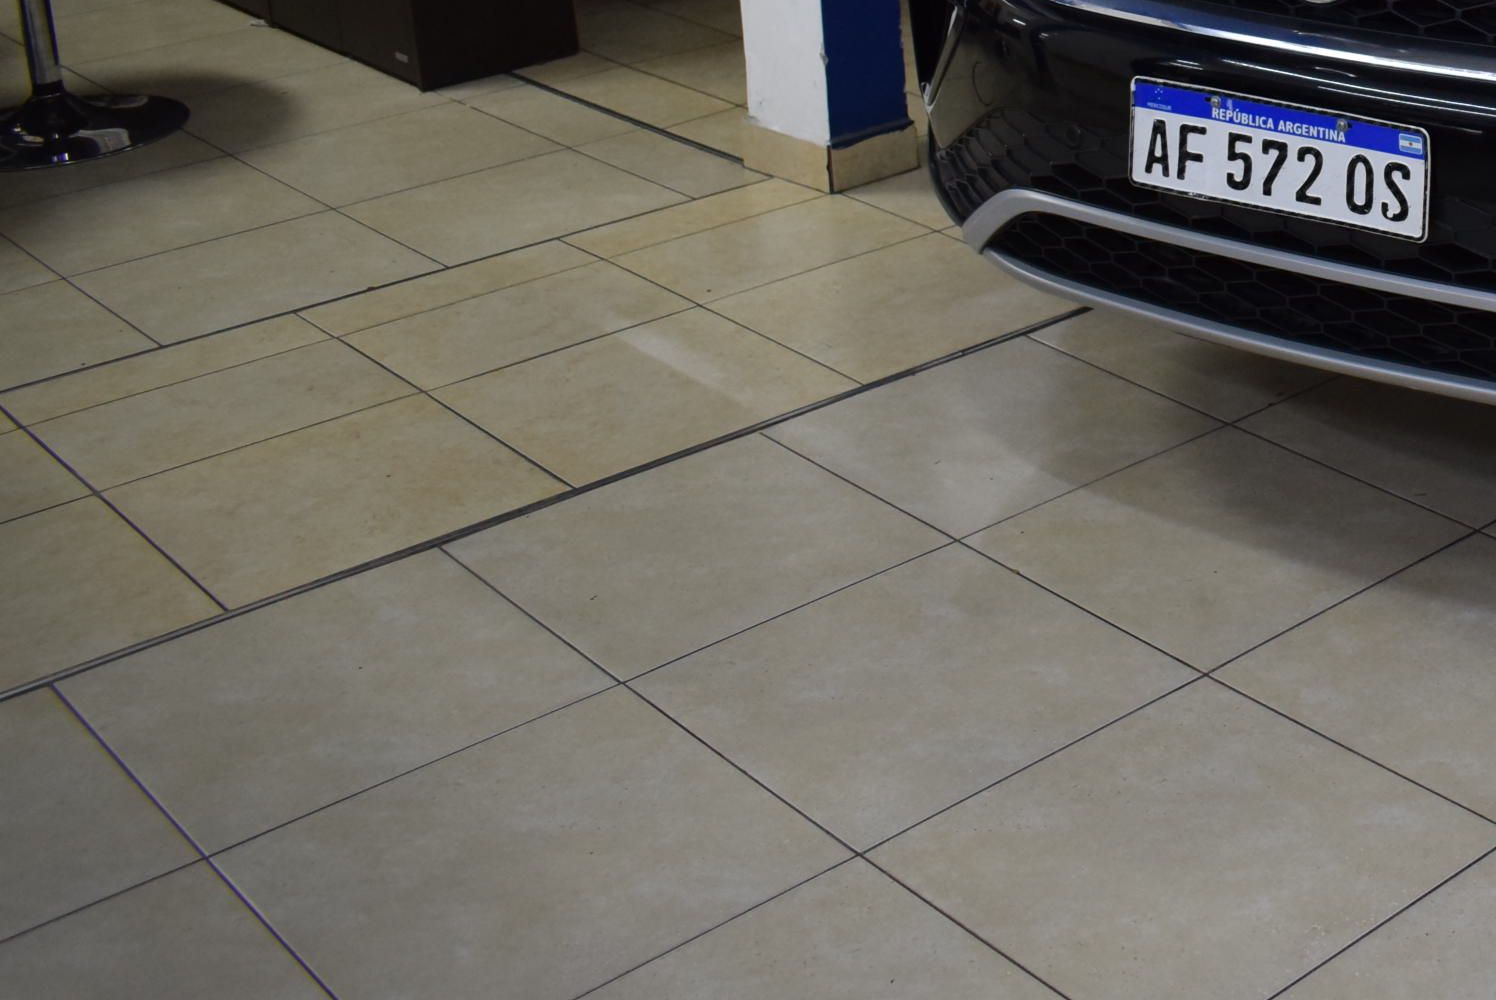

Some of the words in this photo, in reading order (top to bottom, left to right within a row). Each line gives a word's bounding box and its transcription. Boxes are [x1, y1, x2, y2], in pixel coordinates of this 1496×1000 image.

[1211, 106, 1274, 130] REPÚBLICA
[1277, 120, 1347, 143] ARGENTINA
[1145, 118, 1207, 180] AF
[1226, 131, 1324, 207] 572
